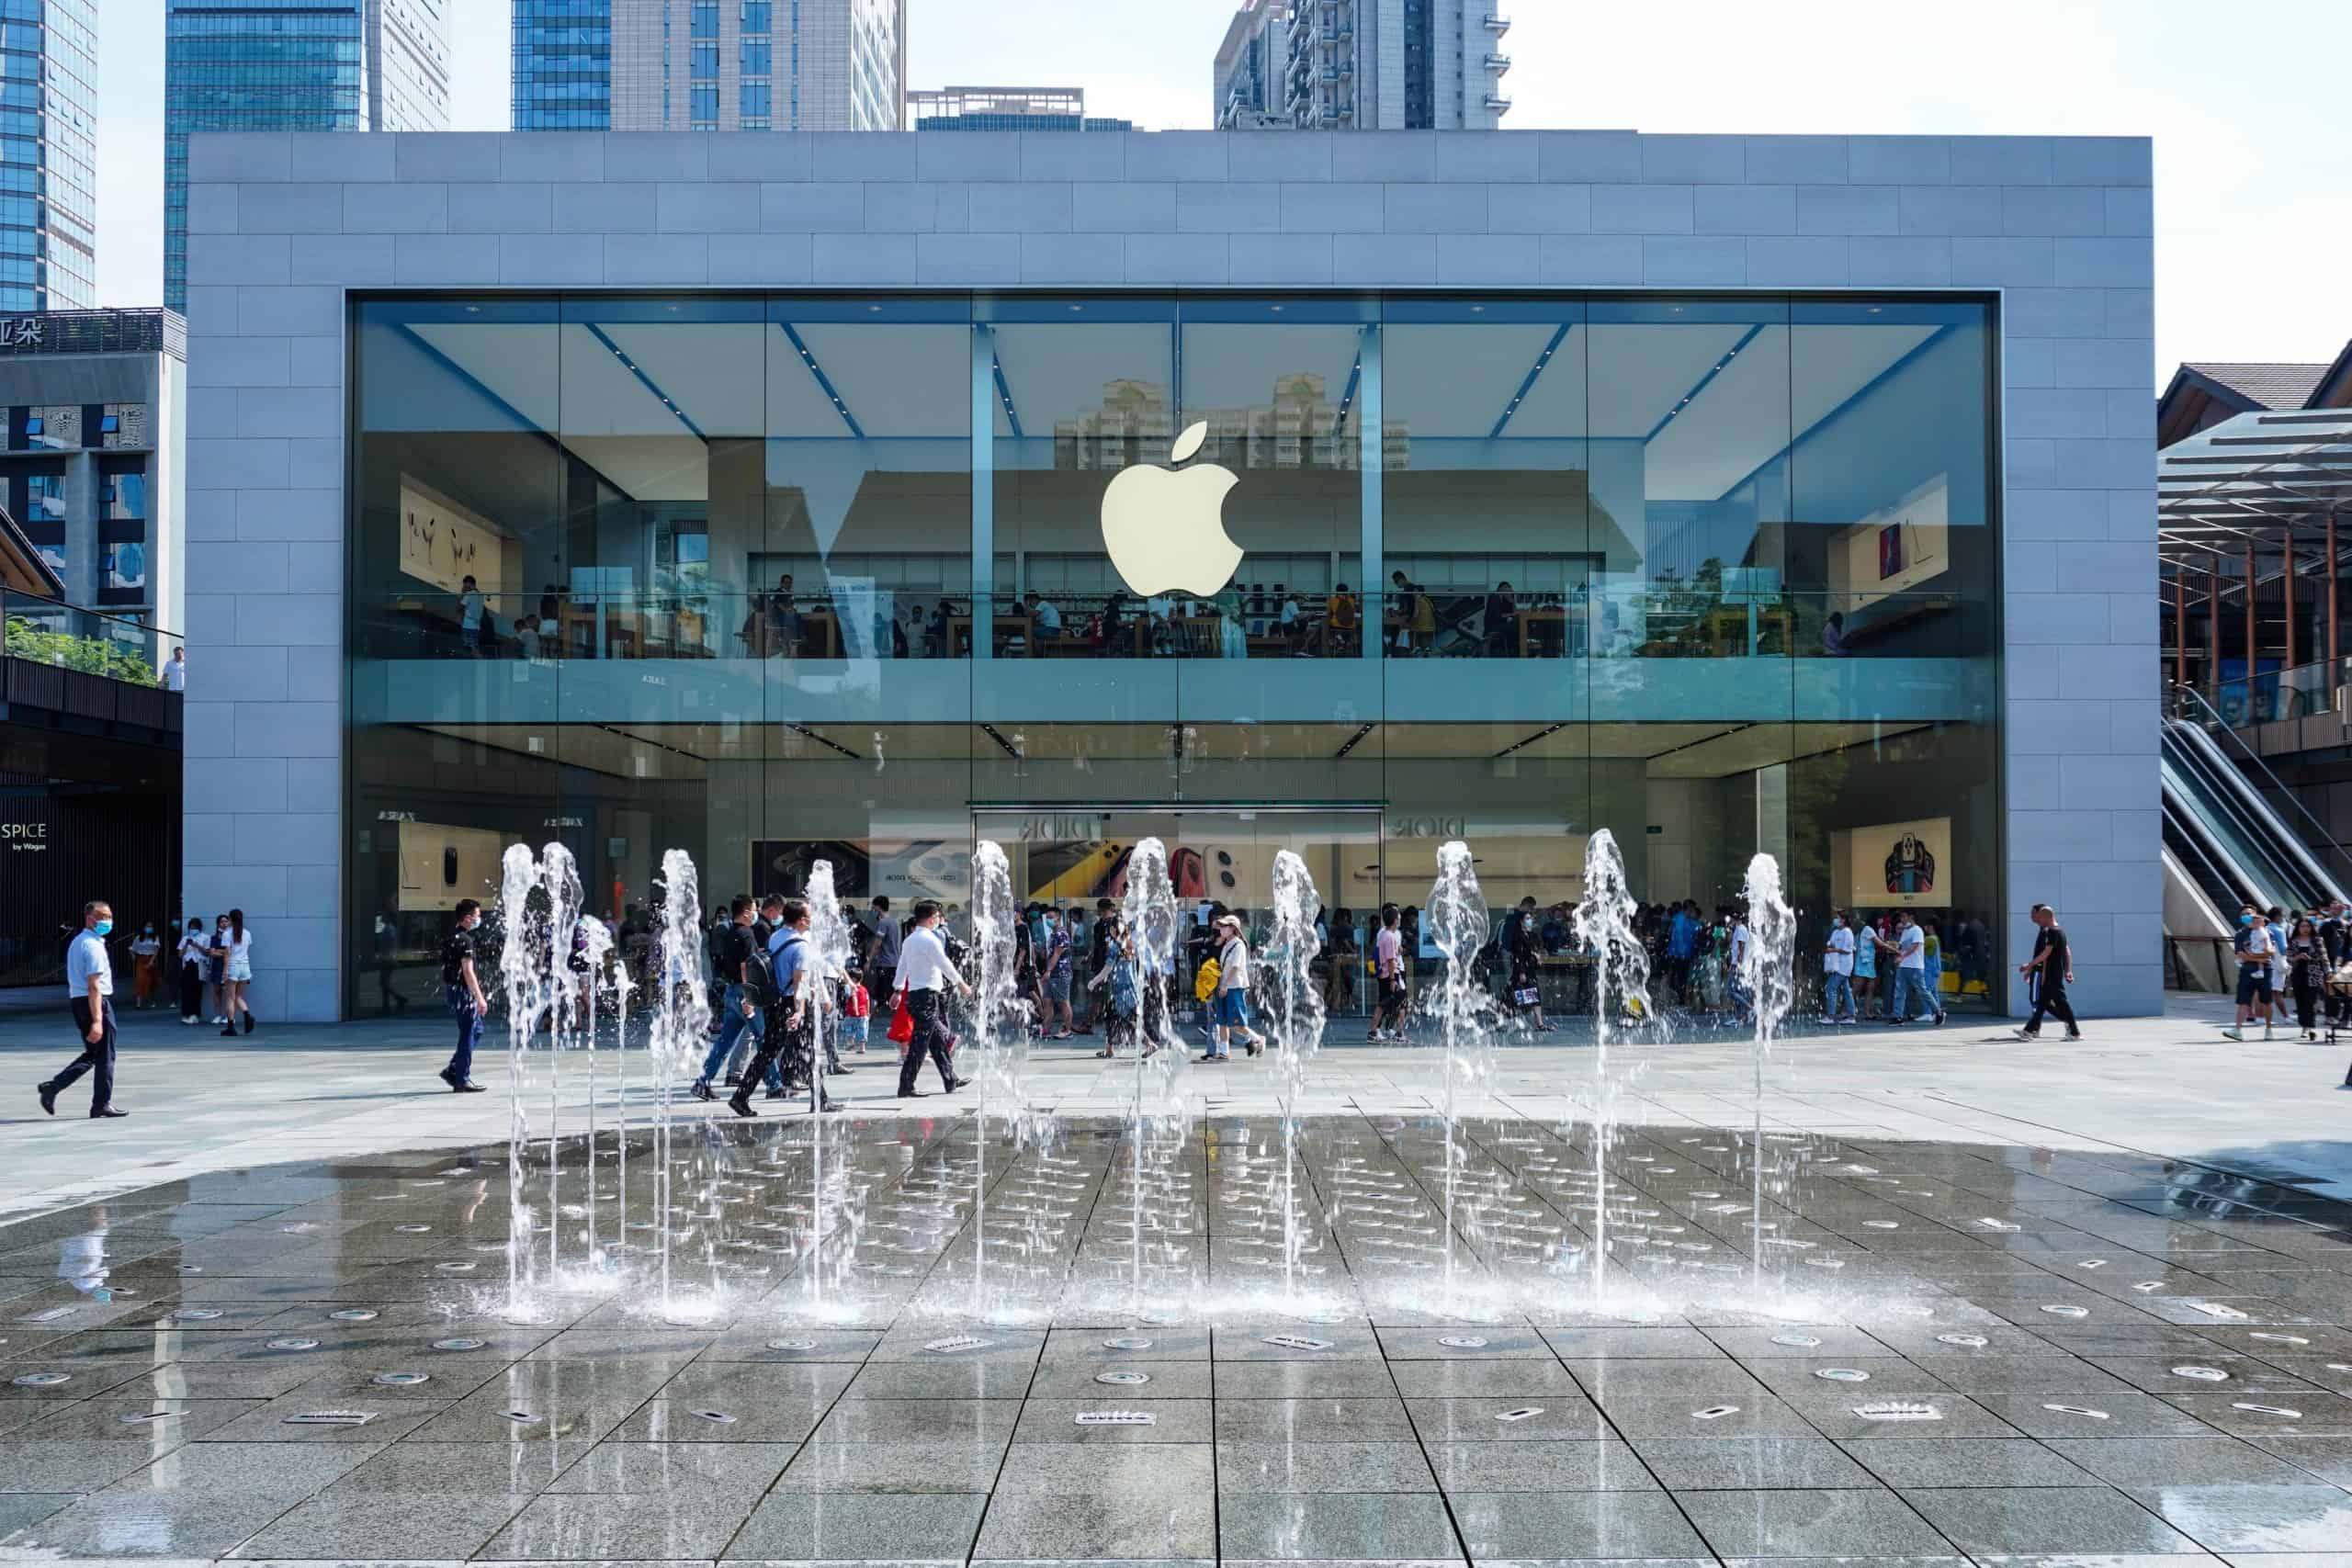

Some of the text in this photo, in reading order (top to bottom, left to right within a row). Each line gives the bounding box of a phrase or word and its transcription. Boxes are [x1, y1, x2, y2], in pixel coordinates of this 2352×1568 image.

[1, 824, 47, 838] SPICE
[13, 843, 46, 852] by Wagas
